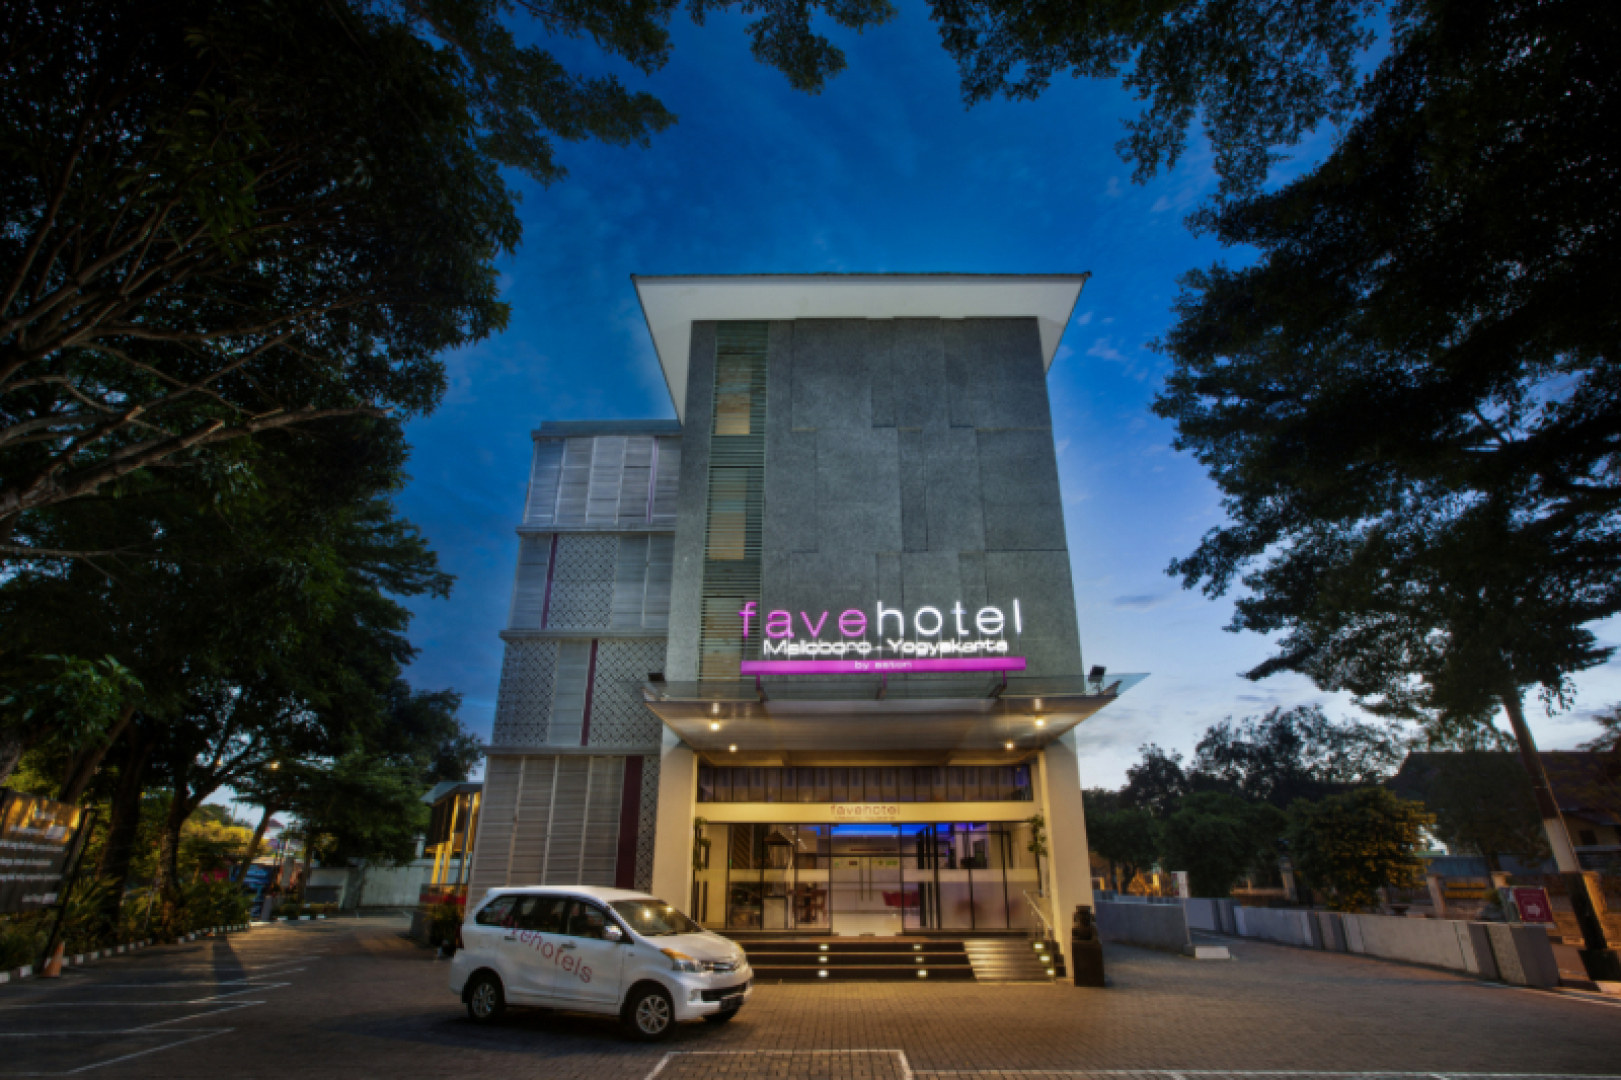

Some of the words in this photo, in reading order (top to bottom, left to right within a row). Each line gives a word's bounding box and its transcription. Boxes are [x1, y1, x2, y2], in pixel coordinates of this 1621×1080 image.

[738, 598, 1022, 639] favehotel
[887, 638, 1008, 657] Yogyakarta
[830, 804, 900, 815] favehotel
